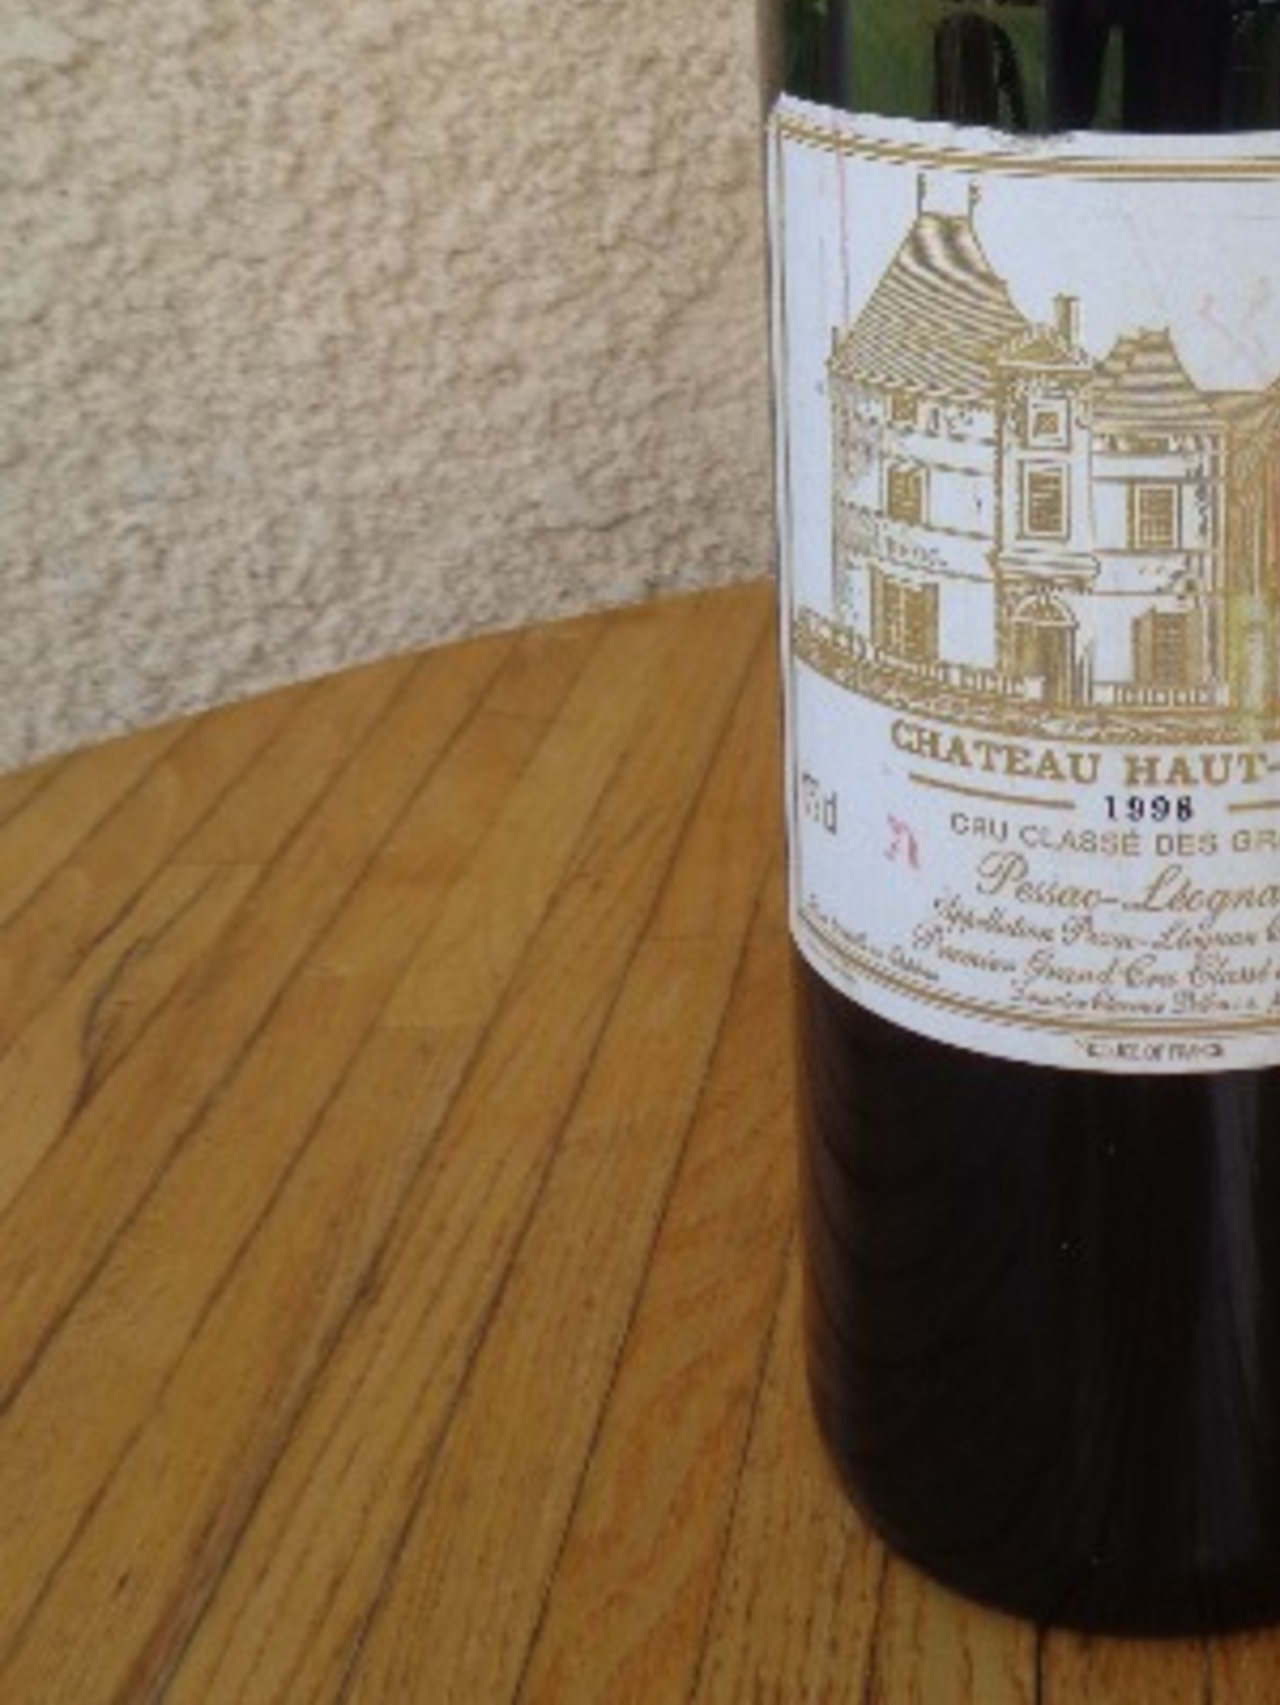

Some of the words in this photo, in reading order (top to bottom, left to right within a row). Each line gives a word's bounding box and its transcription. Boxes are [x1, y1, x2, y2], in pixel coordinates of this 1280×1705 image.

[890, 717, 1101, 786] CHATEAU
[1103, 794, 1195, 823] 1998
[950, 812, 1009, 843] CRU
[1154, 832, 1218, 858] DES
